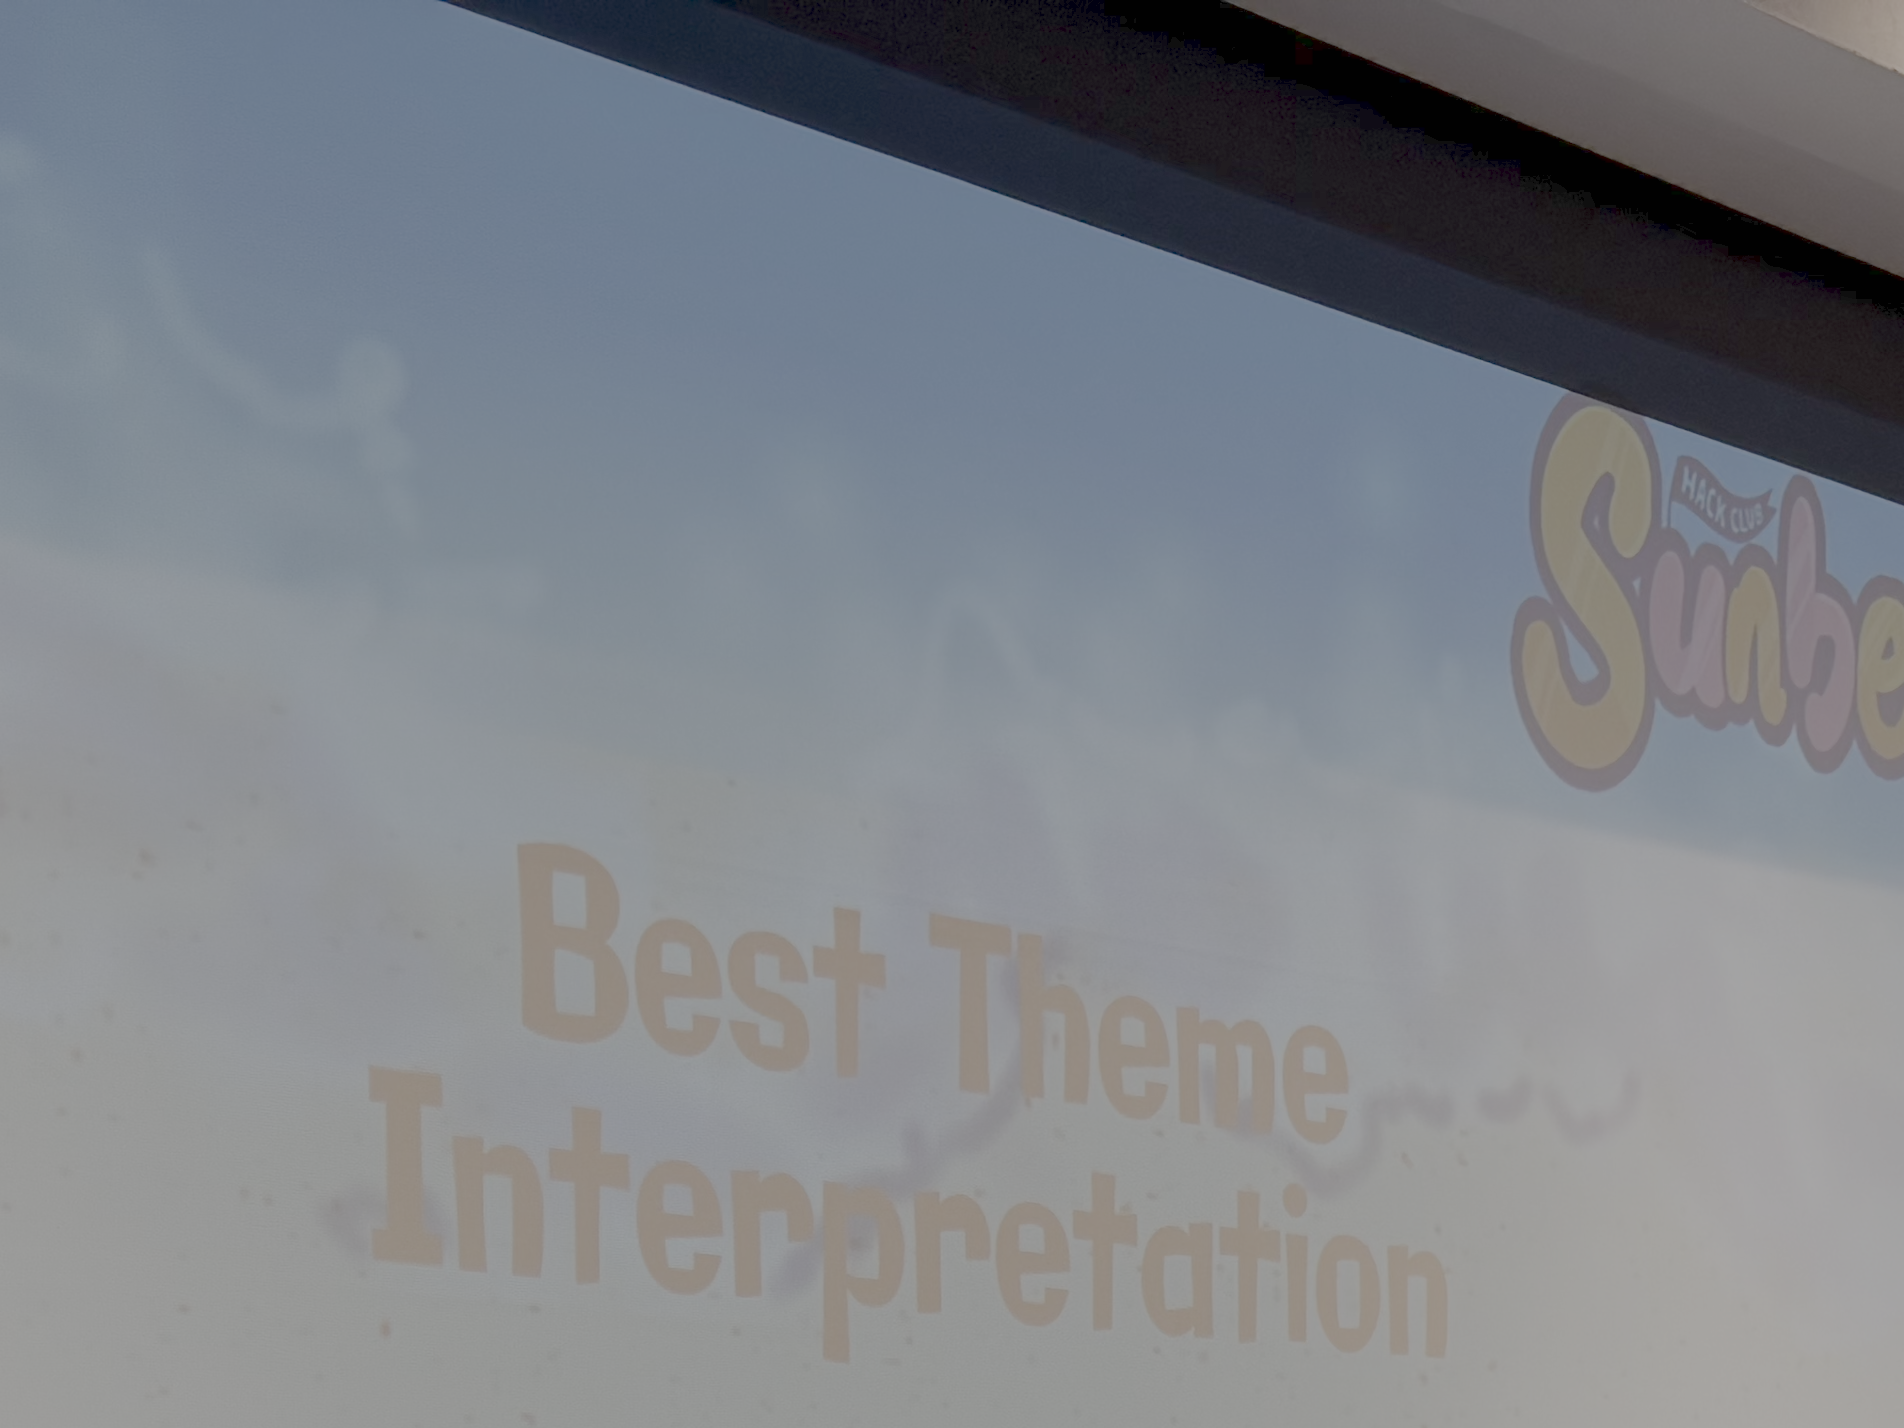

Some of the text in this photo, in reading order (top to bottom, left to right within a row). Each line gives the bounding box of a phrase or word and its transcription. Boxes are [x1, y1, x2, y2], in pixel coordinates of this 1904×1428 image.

[1681, 465, 1764, 534] HACK CLUB
[516, 841, 1351, 1145] Best Theme
[369, 1063, 1449, 1365] Interpretation
